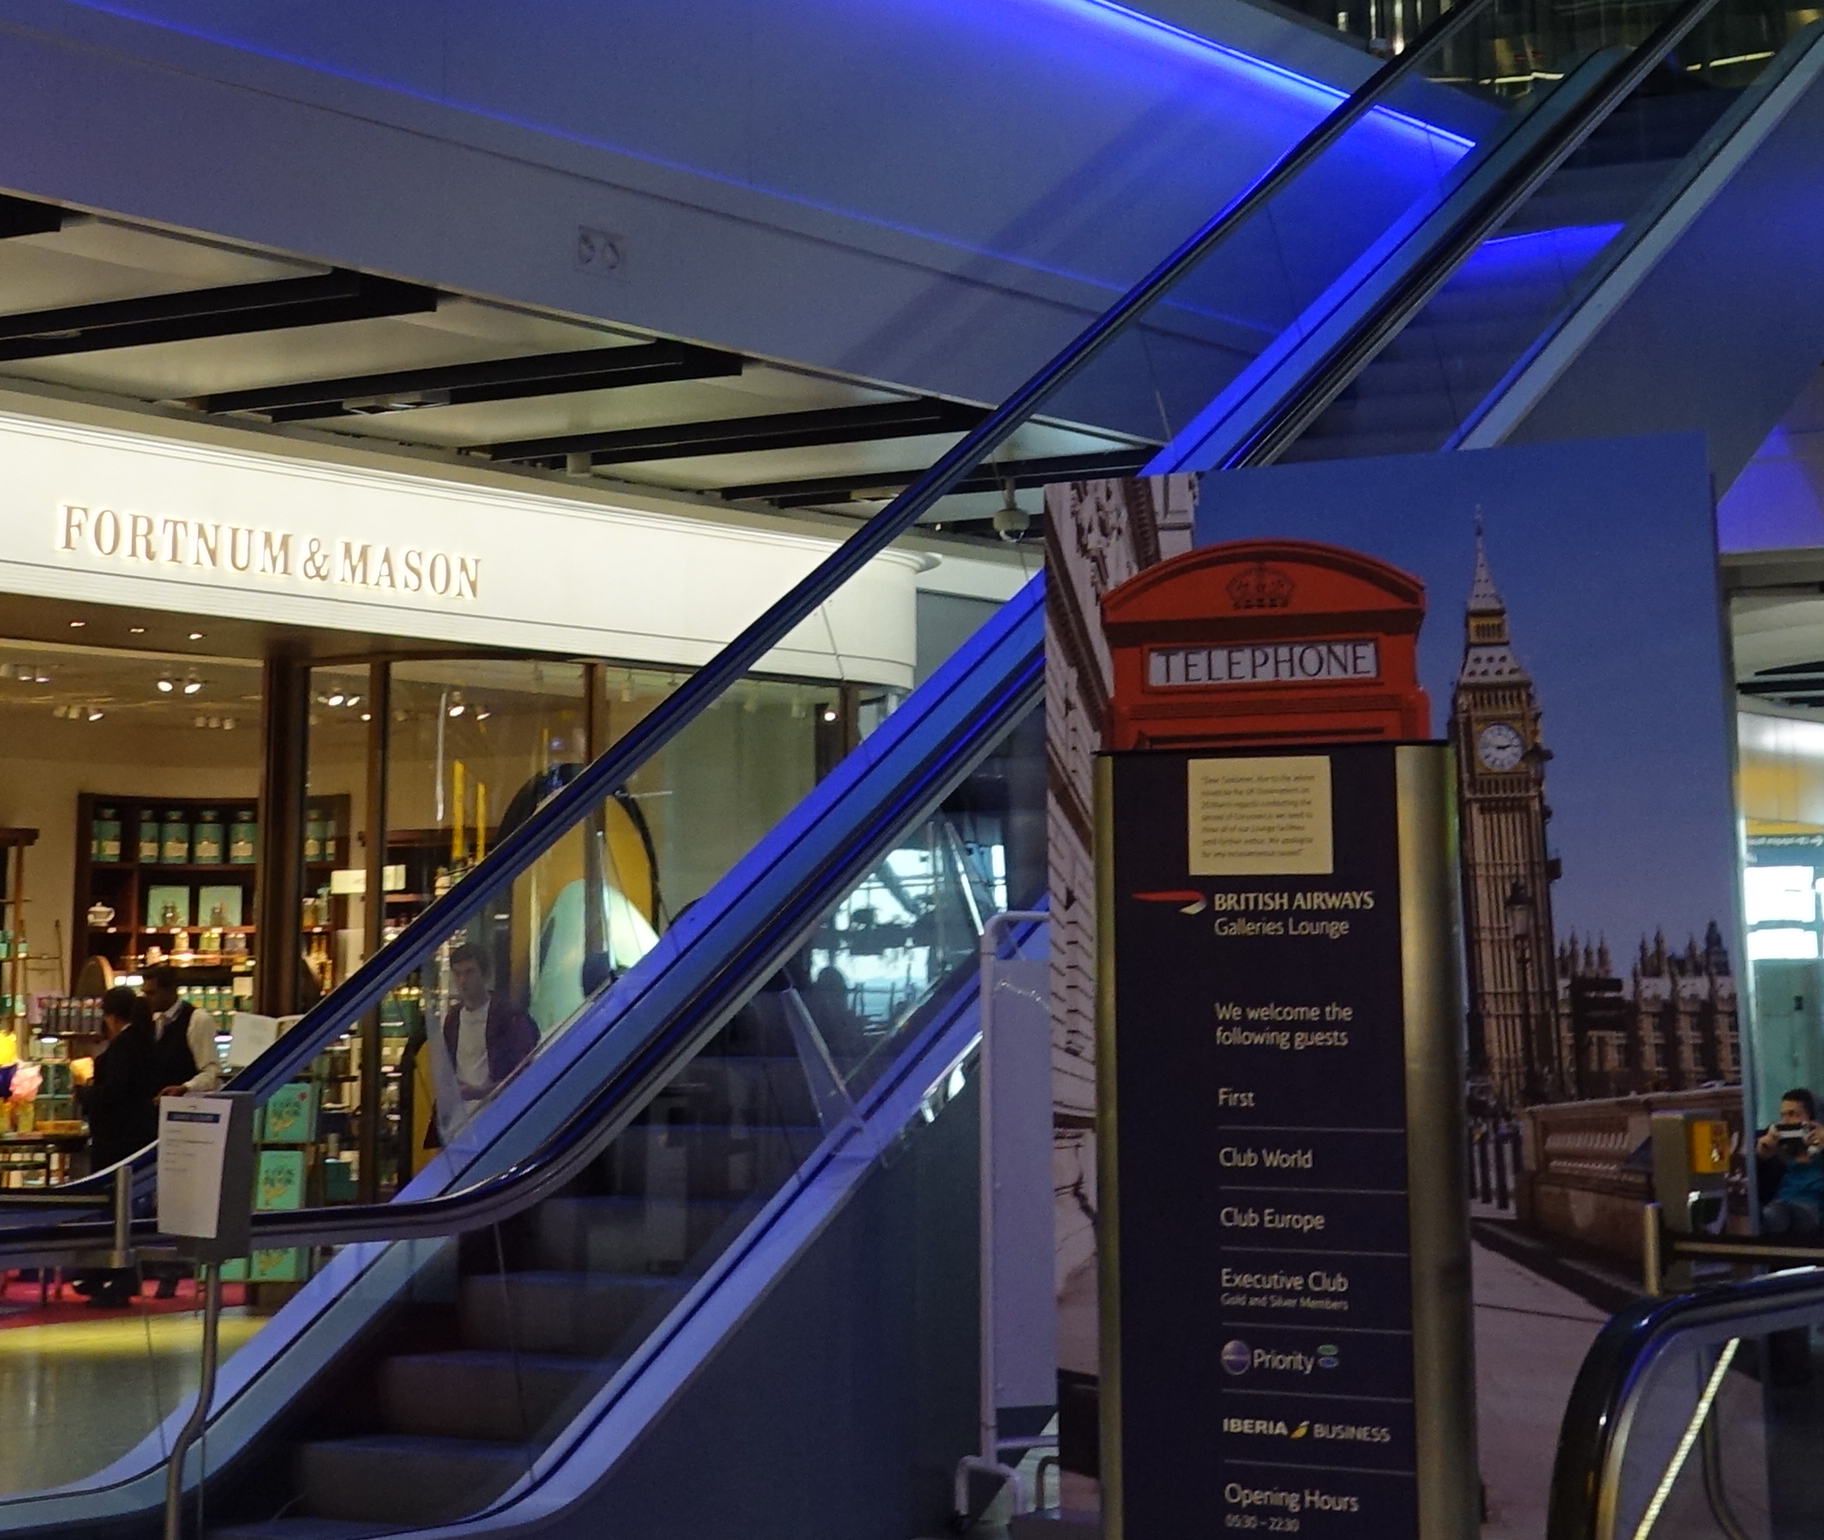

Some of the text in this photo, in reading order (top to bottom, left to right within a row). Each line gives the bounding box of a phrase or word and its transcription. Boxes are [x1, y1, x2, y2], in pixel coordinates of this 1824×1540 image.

[60, 503, 482, 600] FORTNUM & MASON
[1156, 643, 1372, 684] TELEPHONE
[1213, 890, 1376, 911] BRITISH AIRWAYS
[1213, 916, 1351, 939] Galleries Lounge
[1214, 1002, 1354, 1022] We welcome the
[1215, 1026, 1349, 1050] following guests
[1218, 1087, 1256, 1108] First
[1219, 1146, 1314, 1169] Club World
[1220, 1206, 1326, 1233] Club Europe
[1221, 1268, 1350, 1293] Executive Club
[1253, 1348, 1316, 1375] Priority
[1222, 1417, 1392, 1443] IBERIA BUSINESS
[1224, 1482, 1360, 1513] Opening Hours
